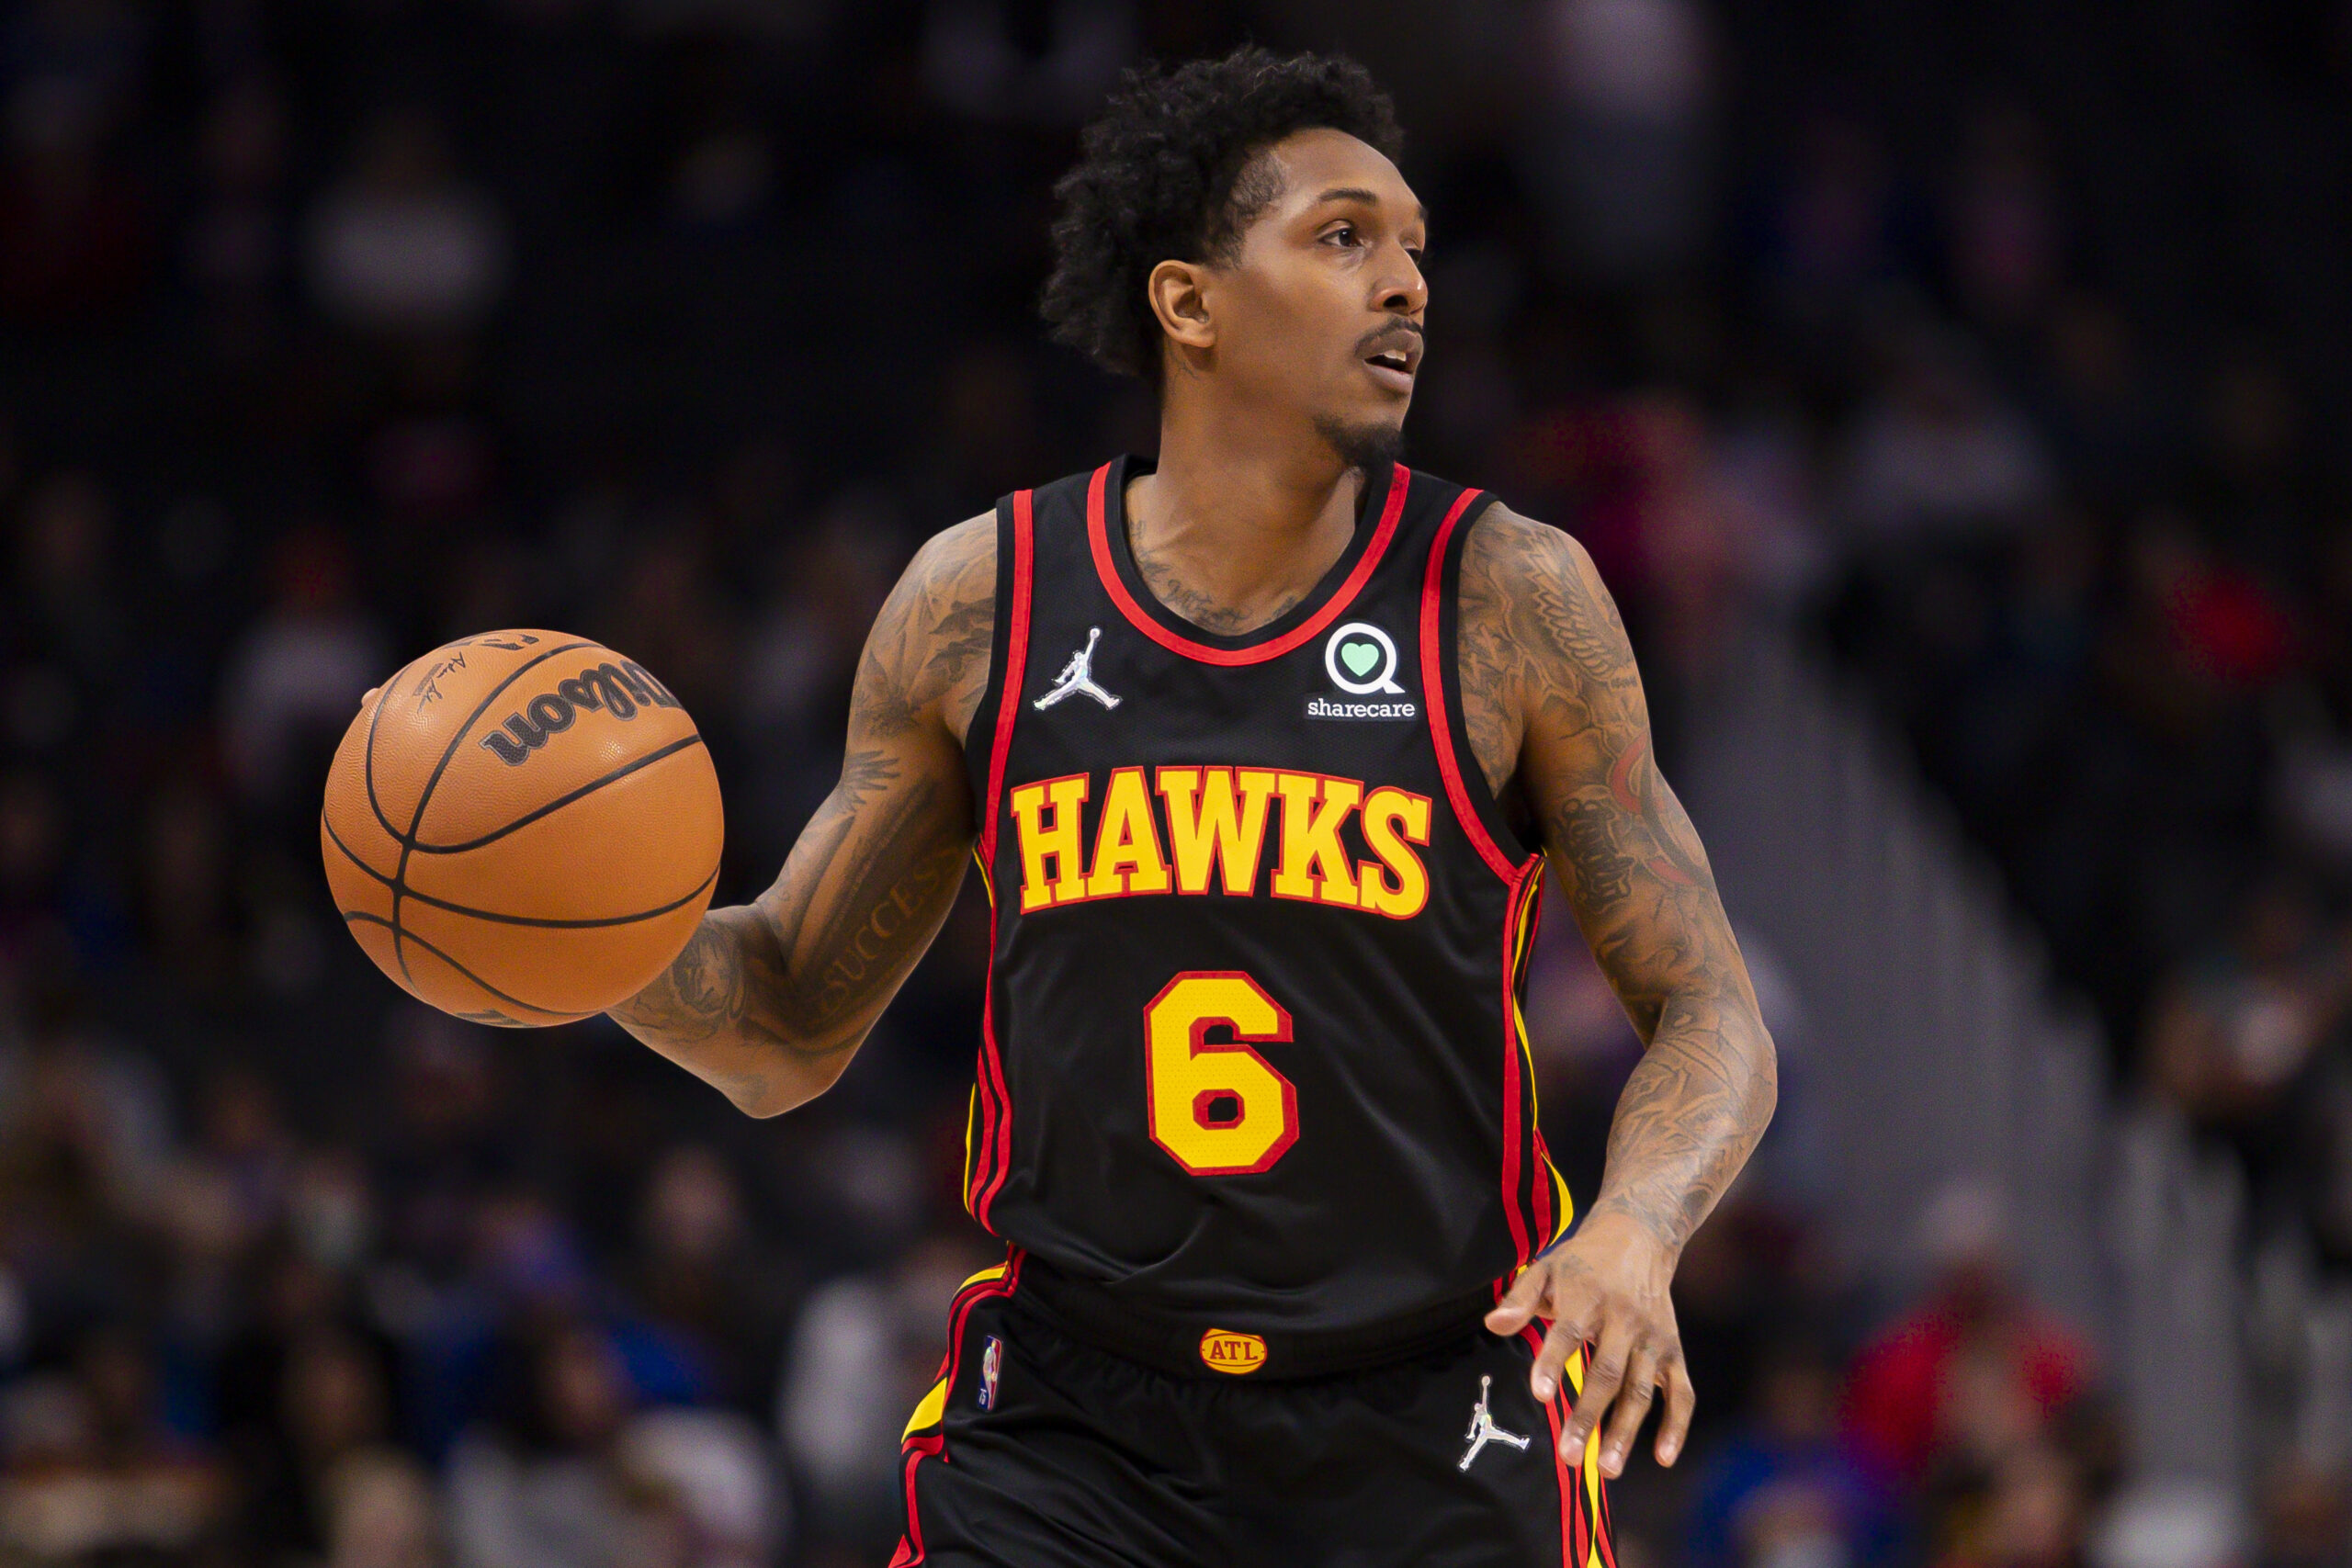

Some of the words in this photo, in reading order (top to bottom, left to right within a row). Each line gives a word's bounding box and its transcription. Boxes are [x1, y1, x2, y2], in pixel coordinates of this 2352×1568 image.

[1307, 698, 1416, 717] sharecare
[1011, 765, 1432, 919] HAWKS
[1143, 971, 1300, 1176] 6
[1209, 1340, 1259, 1360] ATL
